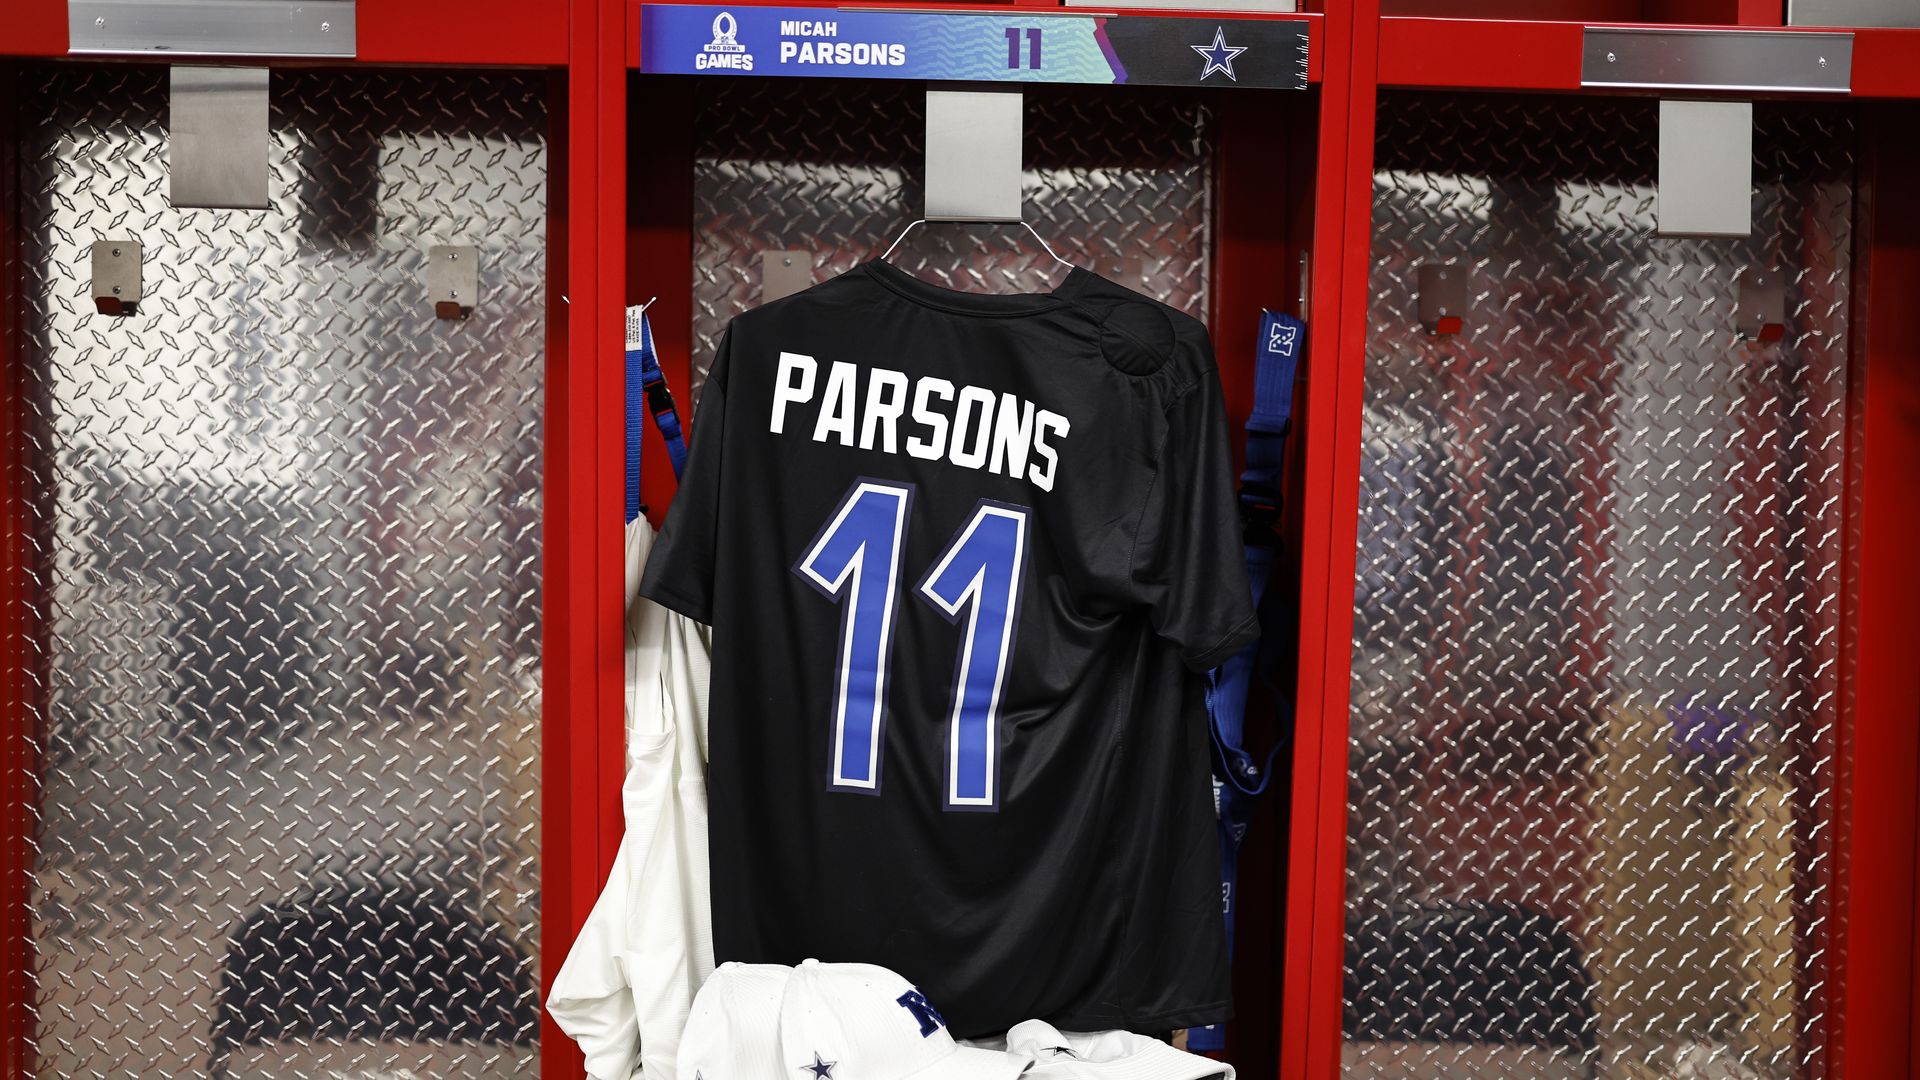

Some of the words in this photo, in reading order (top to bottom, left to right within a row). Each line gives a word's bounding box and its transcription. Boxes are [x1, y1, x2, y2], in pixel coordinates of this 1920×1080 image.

[780, 20, 837, 37] MICAH
[695, 53, 754, 71] GAMES
[780, 41, 906, 66] PARSONS
[1005, 27, 1042, 70] 11
[769, 351, 1071, 493] PARSONS
[791, 475, 1032, 813] 11
